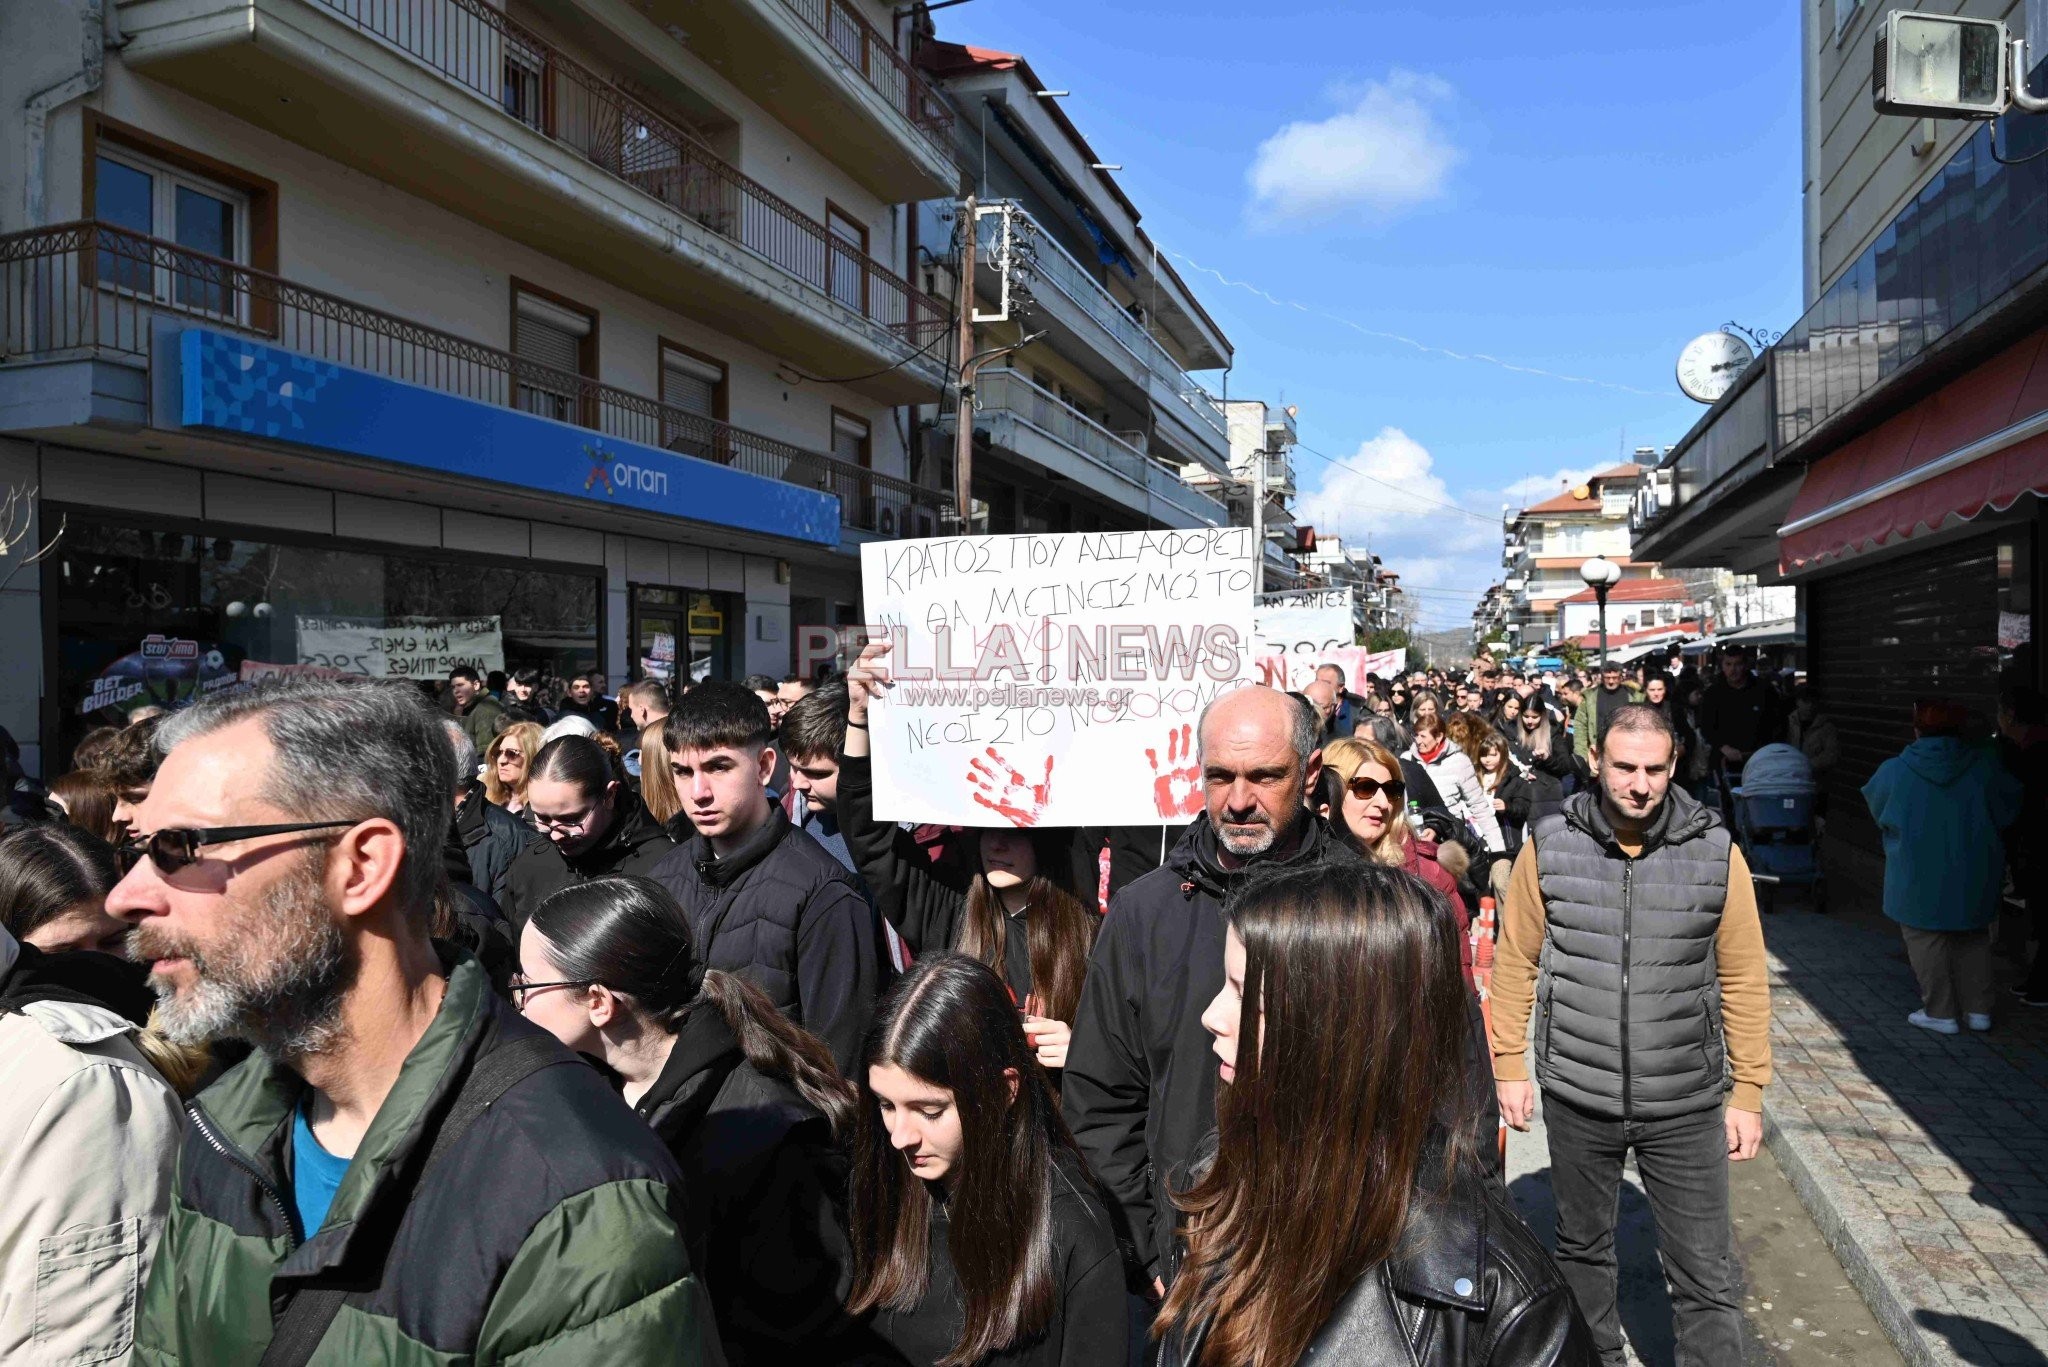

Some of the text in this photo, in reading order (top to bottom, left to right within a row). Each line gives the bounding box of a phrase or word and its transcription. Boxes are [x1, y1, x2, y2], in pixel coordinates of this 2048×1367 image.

[884, 528, 1250, 595] ΚΡΑΤΟΣ ΠΟΥ ΑΔΙΑΦΟΡΕΙ
[926, 600, 970, 635] ΘΑ
[986, 573, 1137, 623] ΜΕΙΝΕΙΣ
[1144, 569, 1198, 604] ΜΕΣ
[1207, 569, 1251, 597] ΤΟ
[1290, 591, 1347, 609] ΖΗΜΙΕΣ
[82, 682, 144, 714] BUILDER
[93, 675, 124, 694] BET
[907, 712, 981, 754] ΝΕΟΙ
[989, 705, 1056, 745] ΣΤΟ
